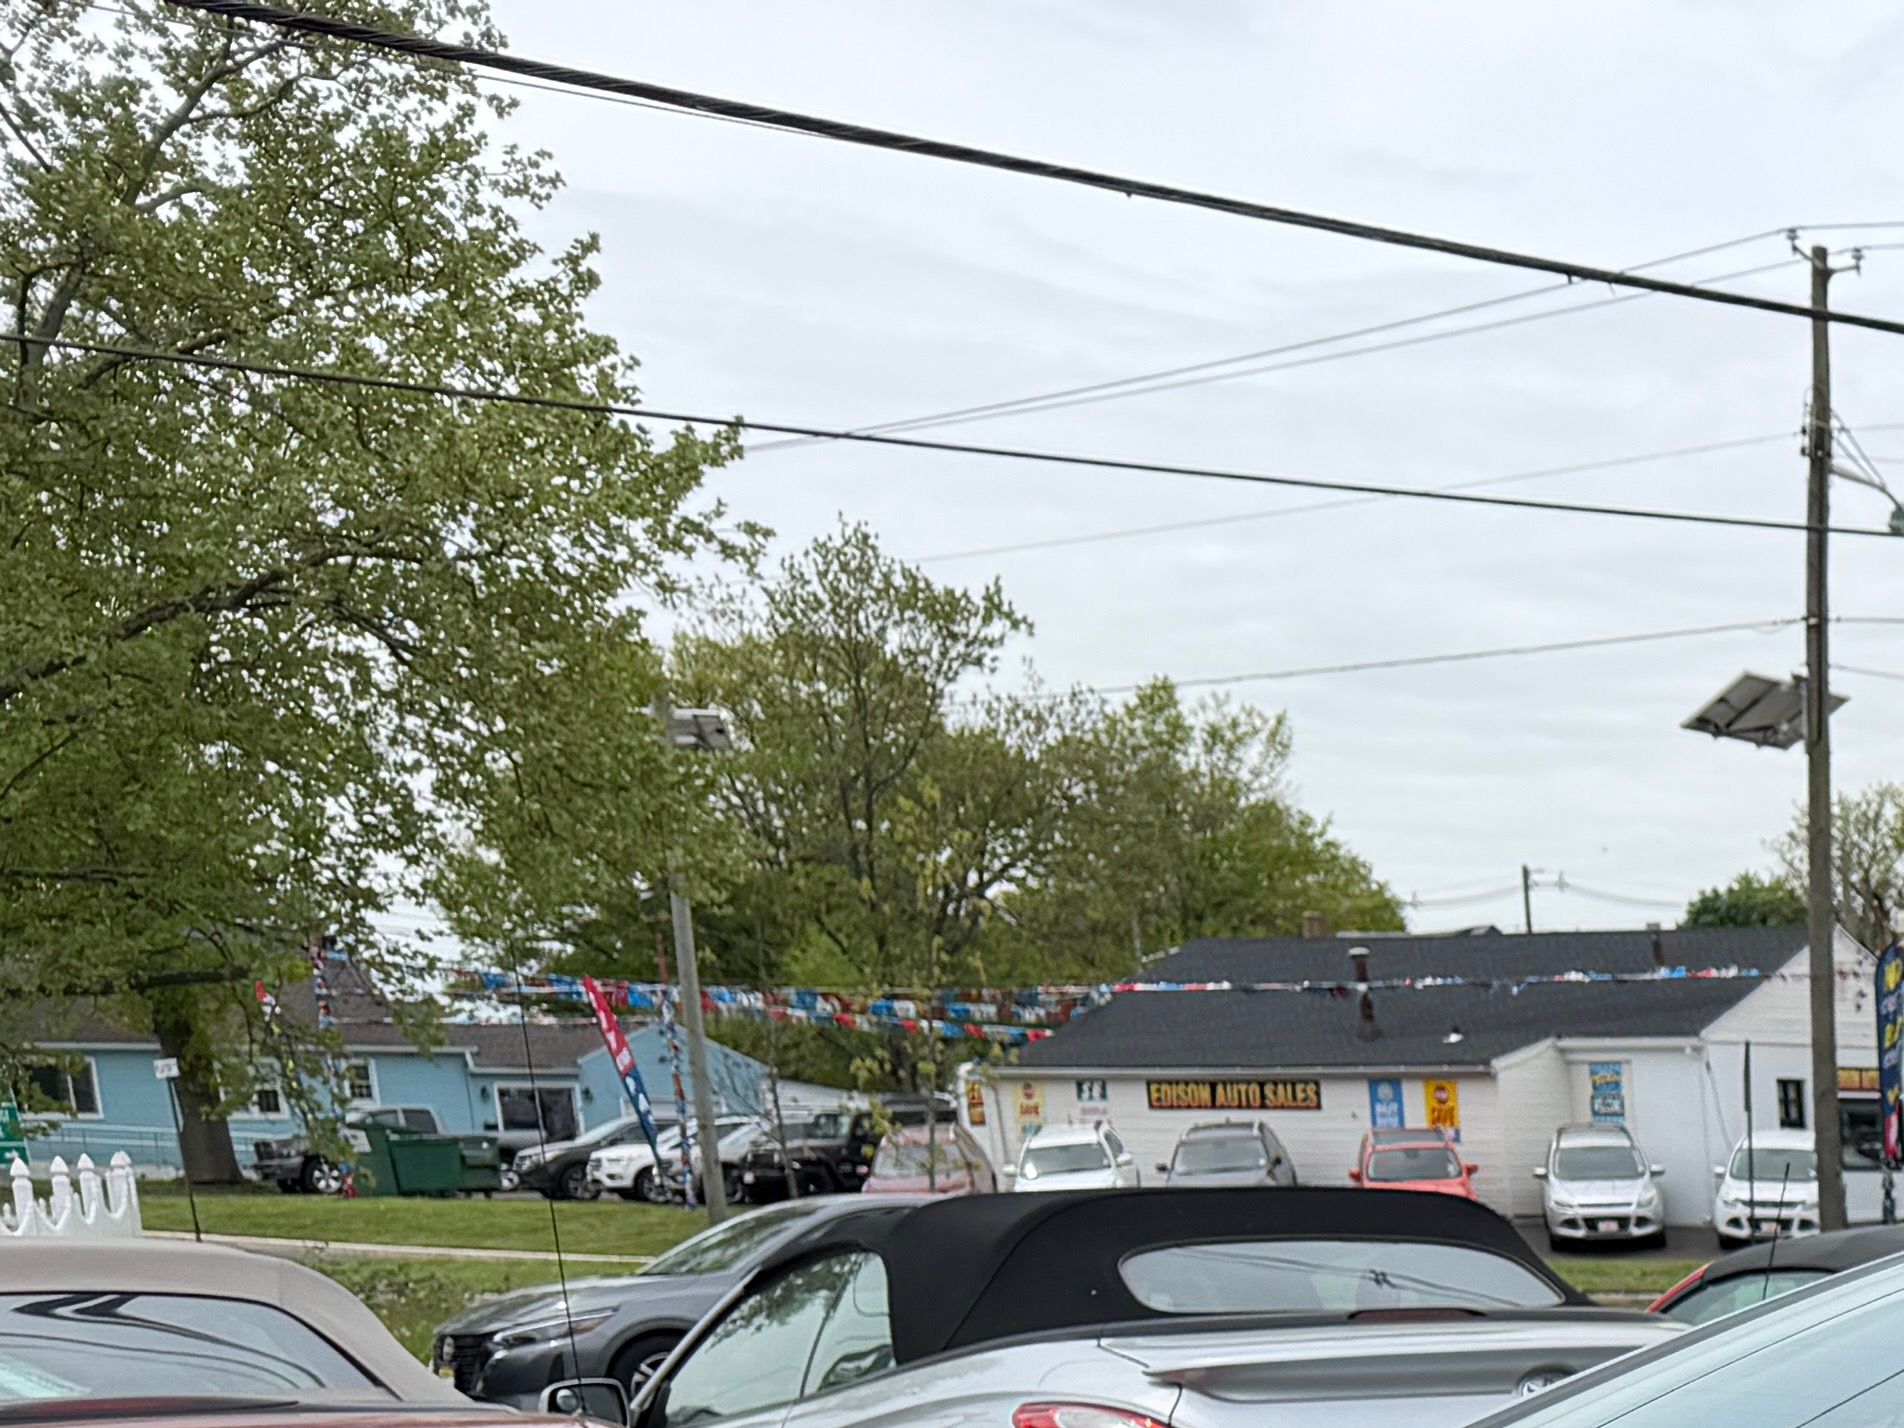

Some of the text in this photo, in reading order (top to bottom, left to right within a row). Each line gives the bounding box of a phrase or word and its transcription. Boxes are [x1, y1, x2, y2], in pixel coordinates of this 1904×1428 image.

[1150, 1082, 1318, 1108] EDISON AUTO SALES
